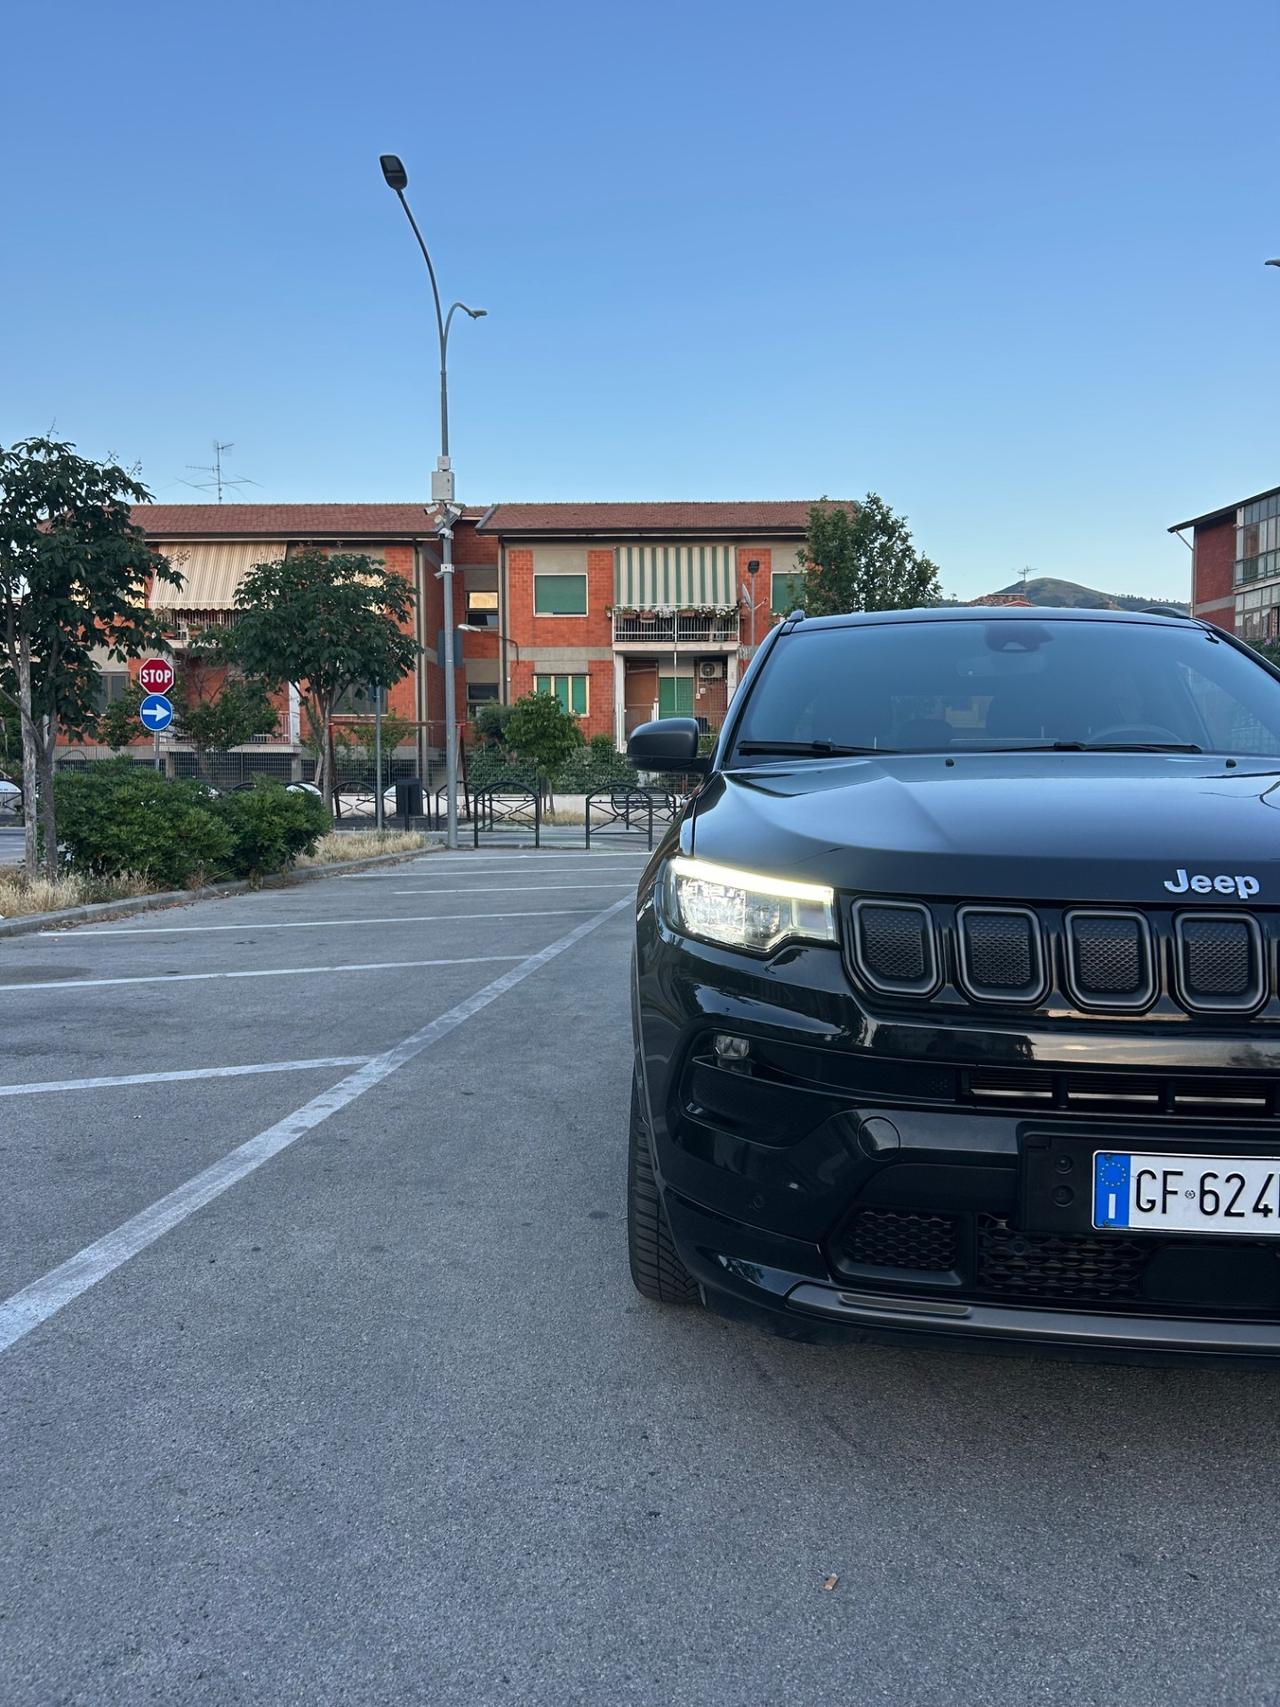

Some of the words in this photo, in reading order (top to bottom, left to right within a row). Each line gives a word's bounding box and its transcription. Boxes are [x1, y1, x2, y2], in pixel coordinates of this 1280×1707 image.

[142, 669, 171, 683] STOP
[1163, 869, 1260, 899] Jeep
[1108, 1193, 1117, 1219] I
[1135, 1169, 1184, 1214] GF
[1199, 1172, 1280, 1218] 624
